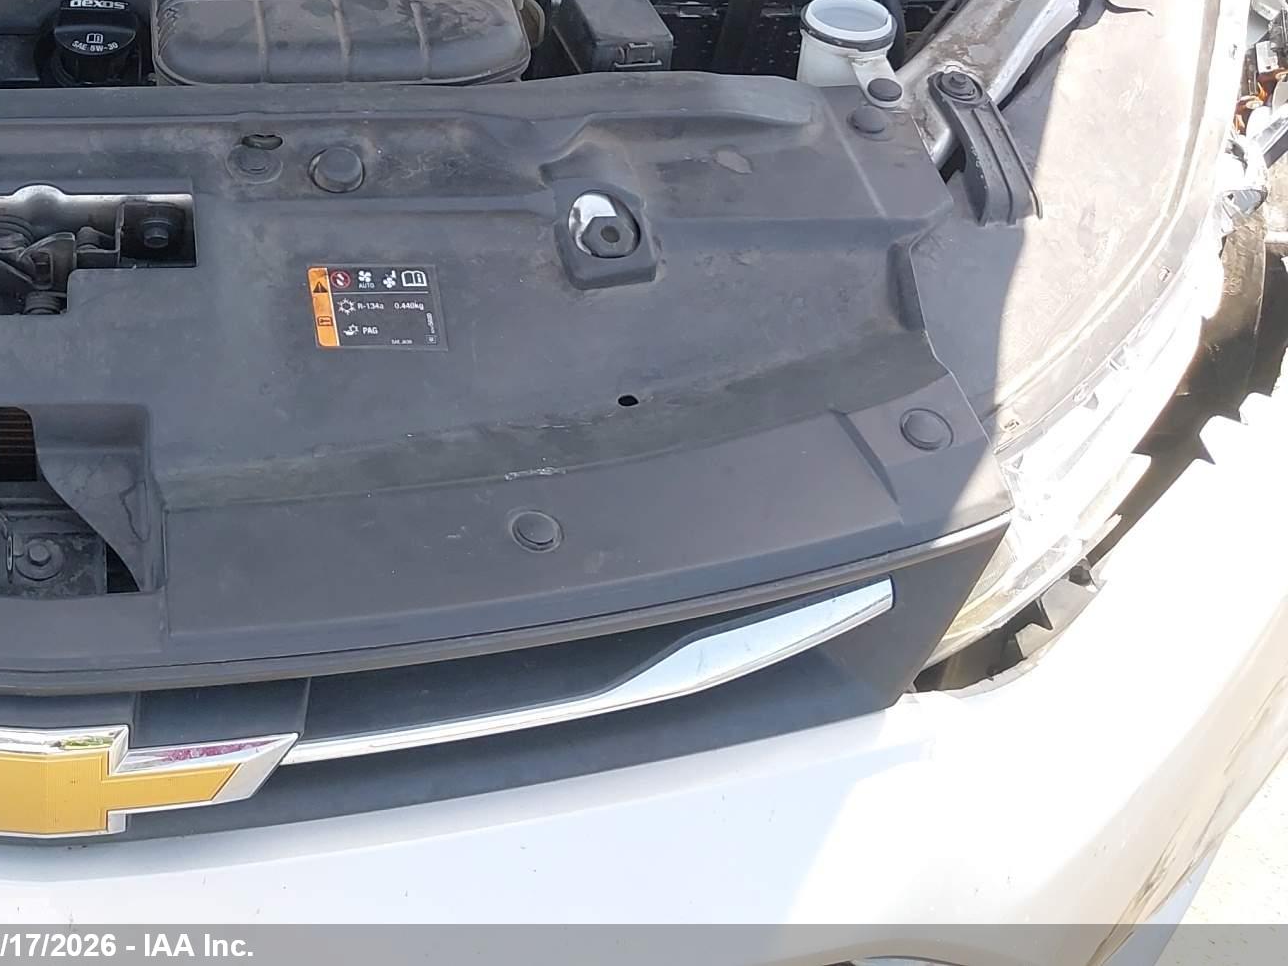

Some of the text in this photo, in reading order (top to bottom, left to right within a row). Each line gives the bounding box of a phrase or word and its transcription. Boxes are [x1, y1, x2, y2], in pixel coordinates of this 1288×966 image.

[72, 40, 119, 52] SAE 5W-30
[357, 300, 424, 311] R-134a 0.440kg
[362, 326, 379, 335] PAG
